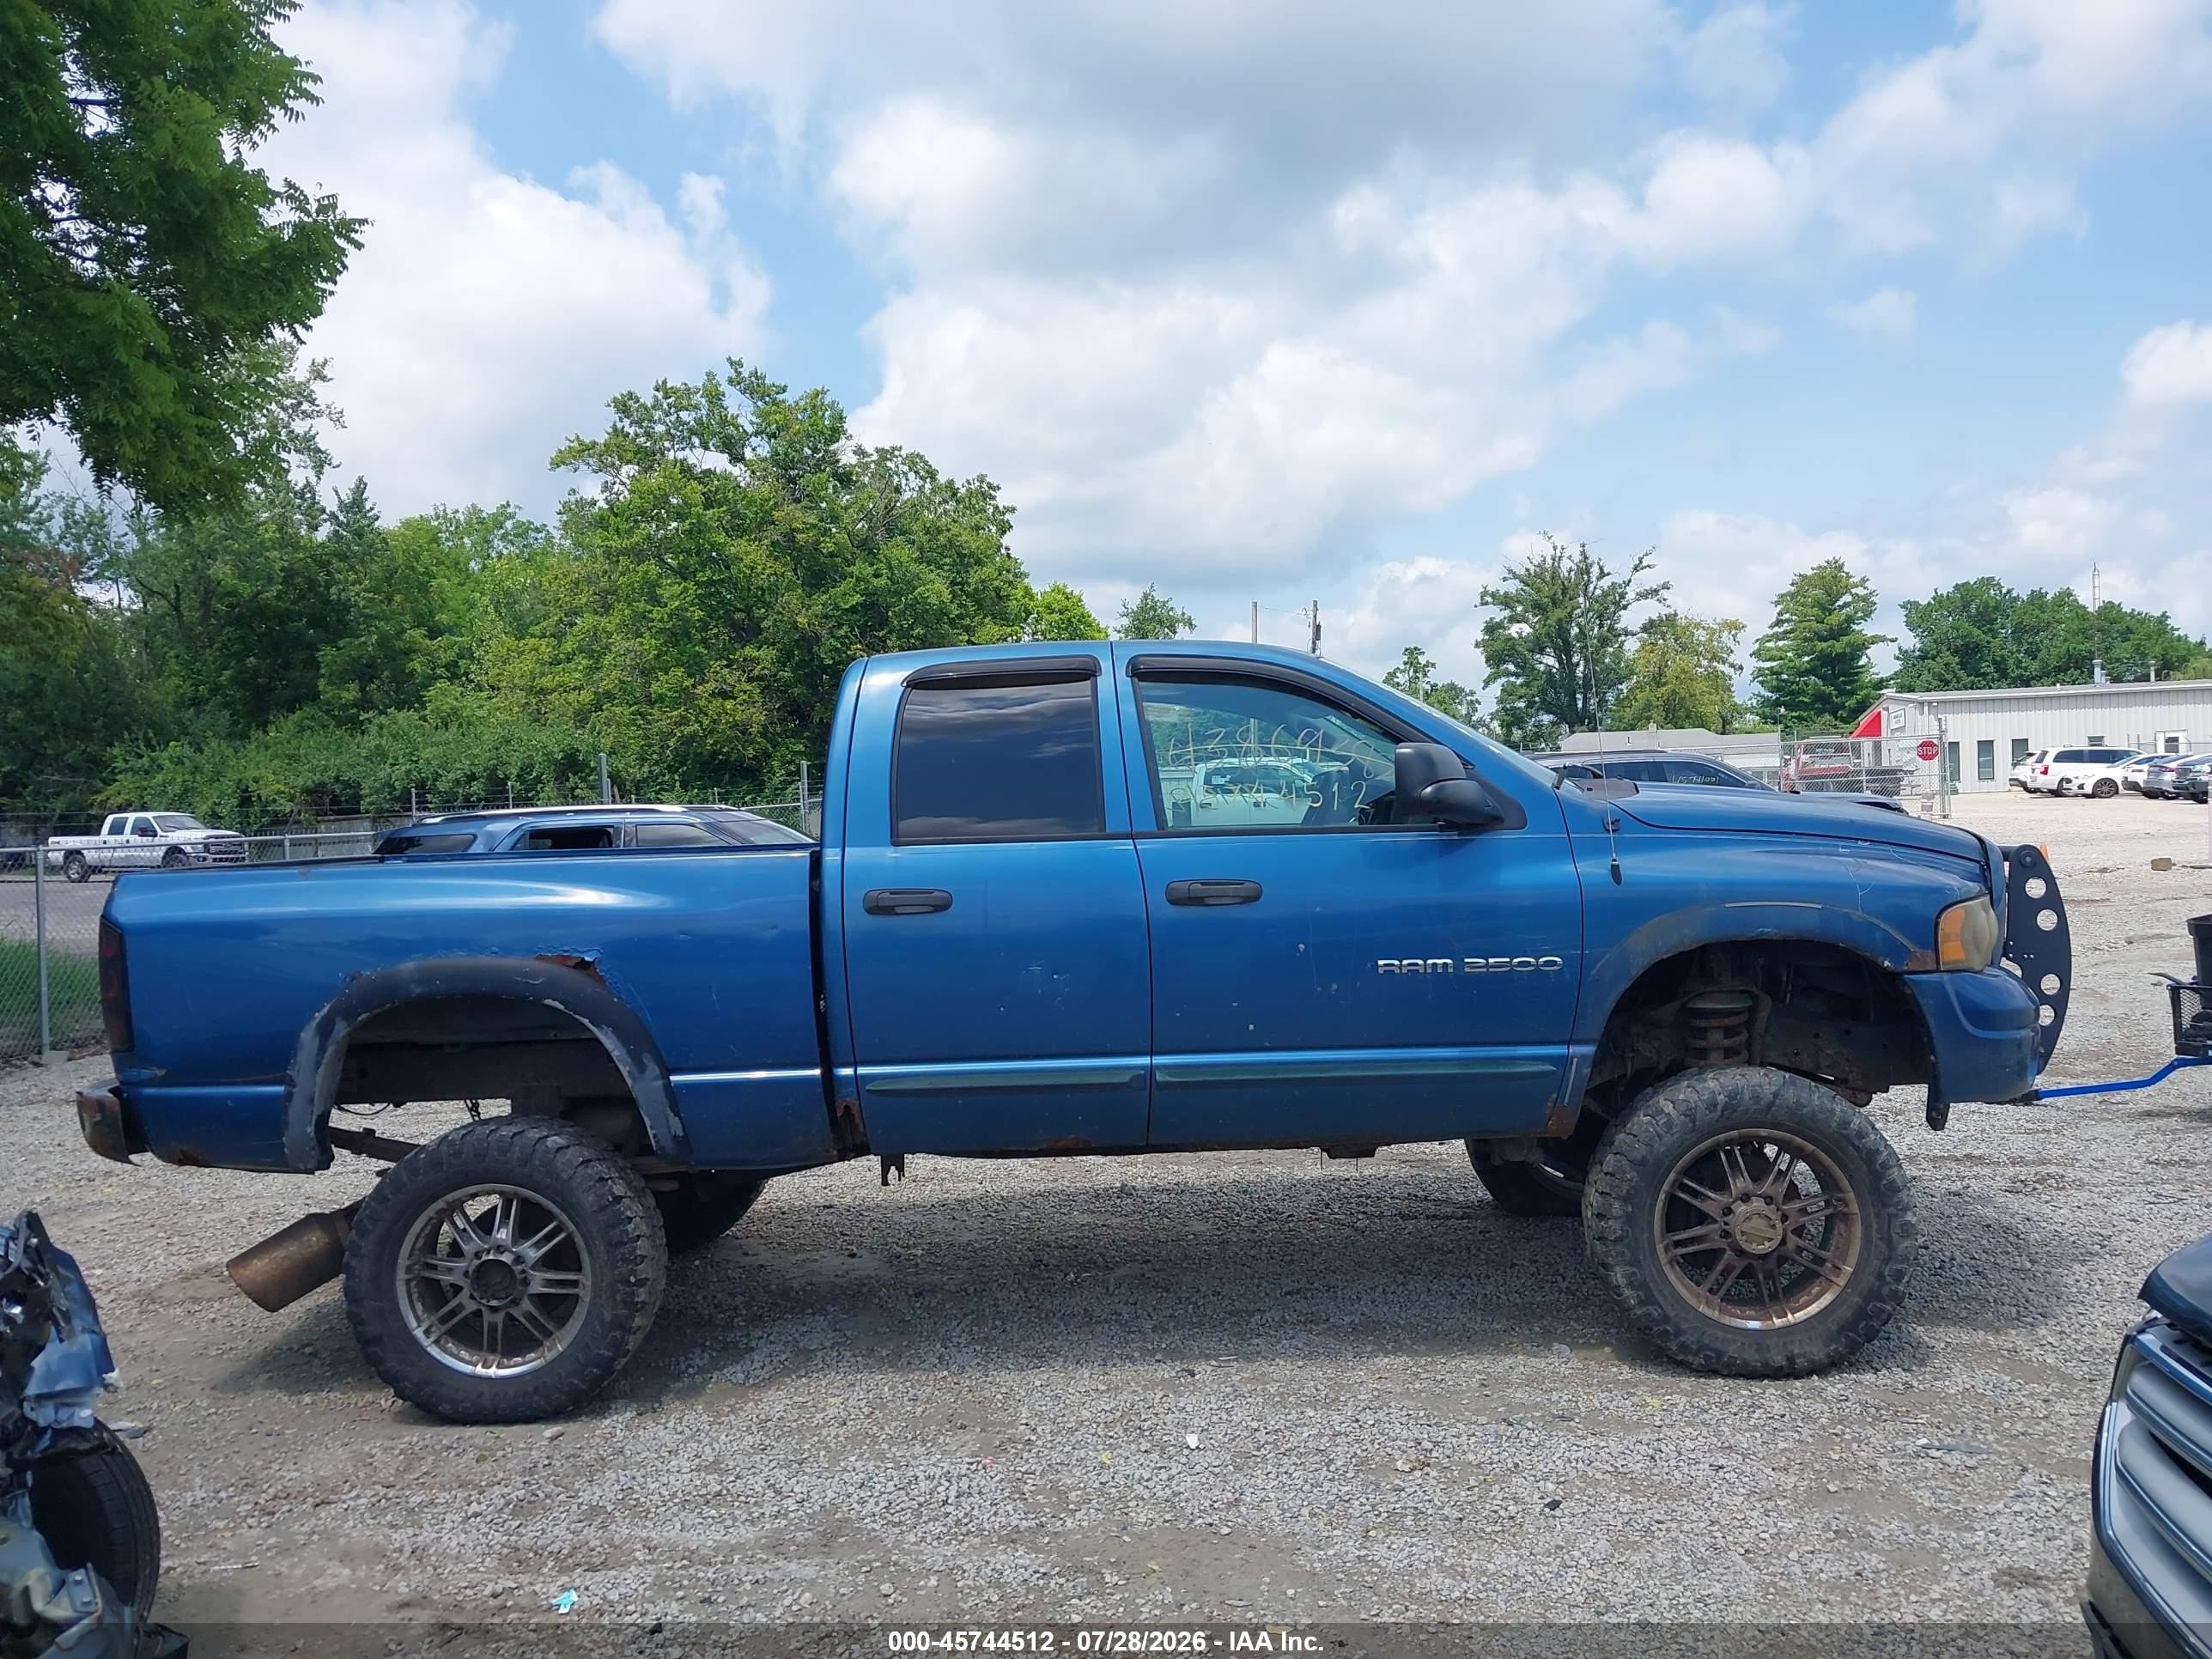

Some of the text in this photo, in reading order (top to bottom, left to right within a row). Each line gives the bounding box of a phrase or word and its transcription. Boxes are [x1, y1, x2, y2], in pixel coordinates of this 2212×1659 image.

[1917, 746, 1938, 757] STOP
[1376, 956, 1564, 974] RAM 2500
